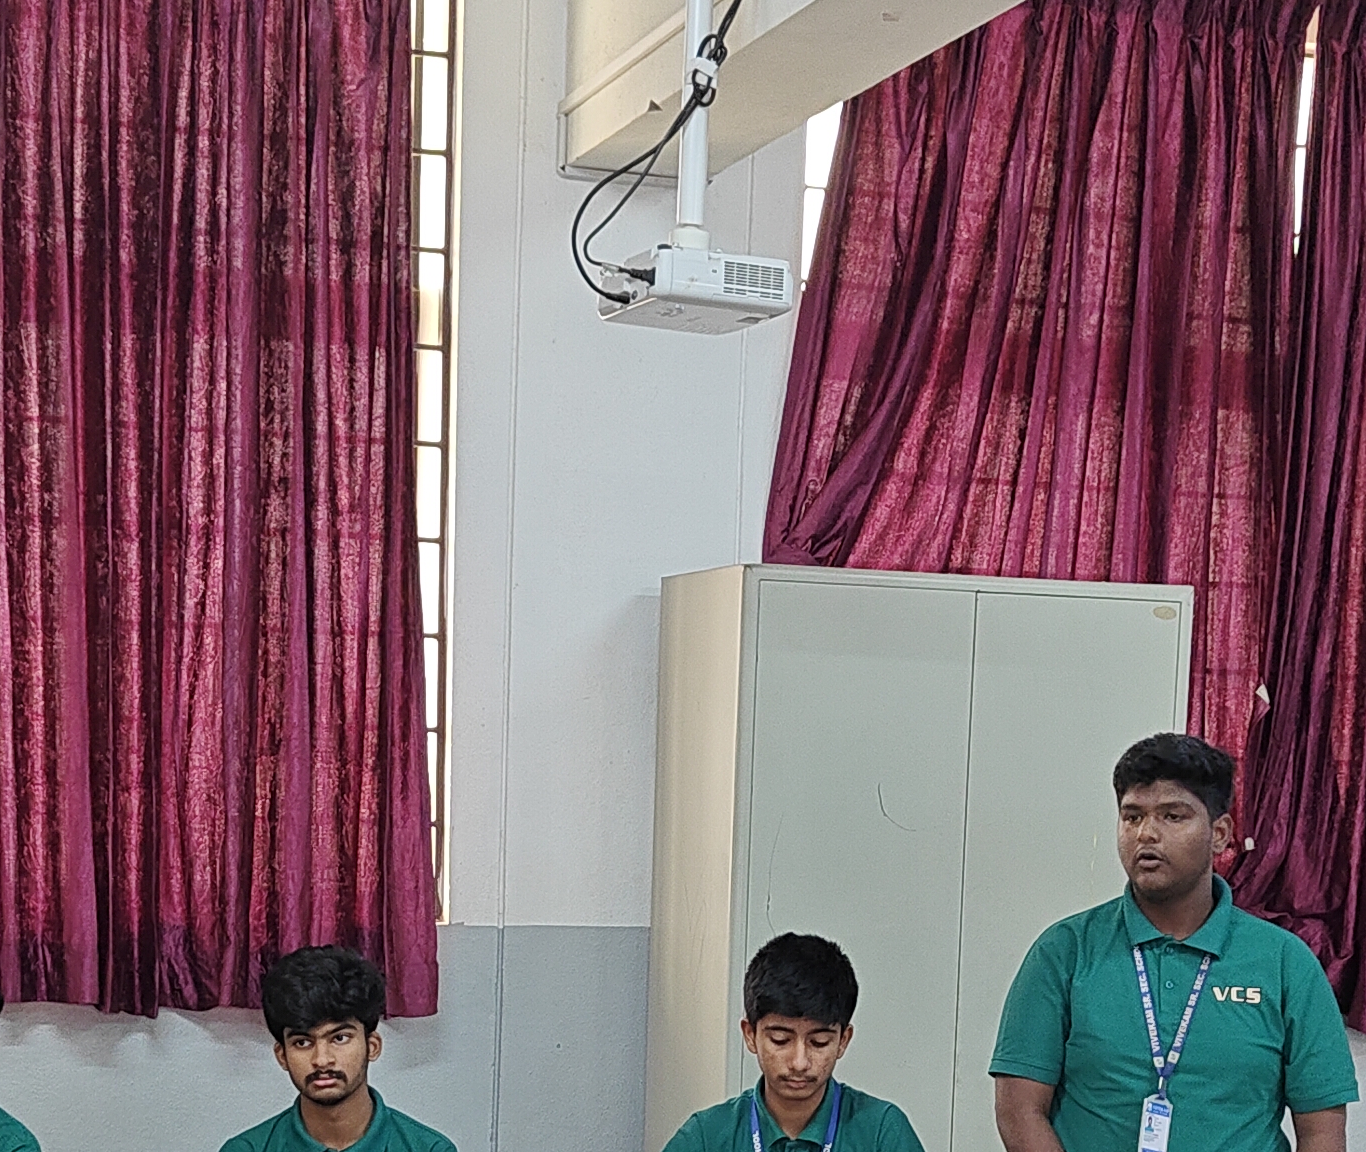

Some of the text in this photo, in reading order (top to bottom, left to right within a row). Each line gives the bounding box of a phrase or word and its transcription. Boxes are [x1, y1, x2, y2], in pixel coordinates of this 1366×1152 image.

[1138, 972, 1148, 992] SEC.
[1192, 970, 1206, 990] SEC.
[1212, 986, 1262, 1004] VCS
